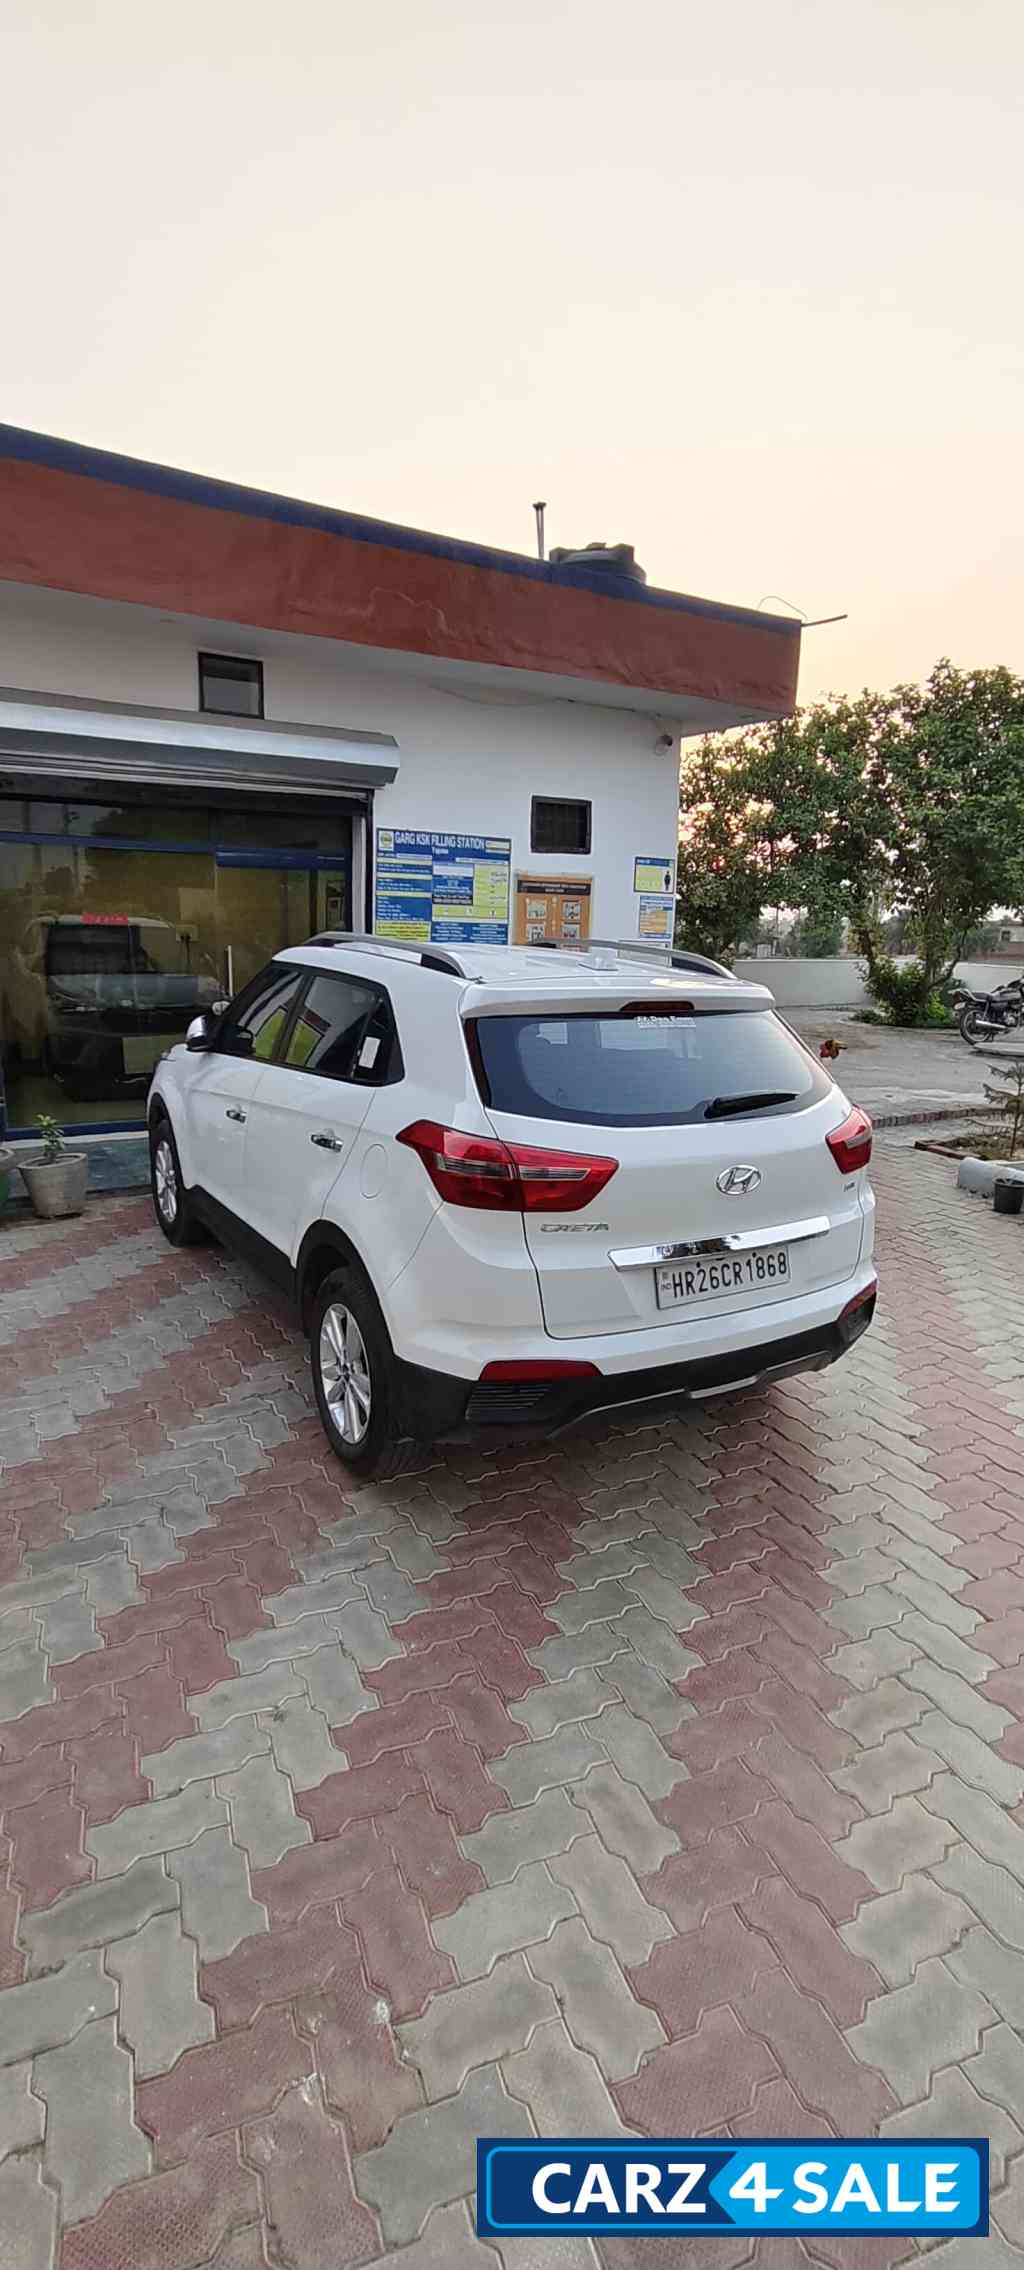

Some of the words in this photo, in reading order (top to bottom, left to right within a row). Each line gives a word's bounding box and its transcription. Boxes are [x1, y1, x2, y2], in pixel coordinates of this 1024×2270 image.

[395, 832, 415, 846] GARG
[415, 833, 430, 847] KSK
[431, 834, 457, 848] FILLING
[457, 837, 485, 850] STATION
[540, 1223, 609, 1233] CRETA
[671, 1251, 788, 1299] HR26CR1868
